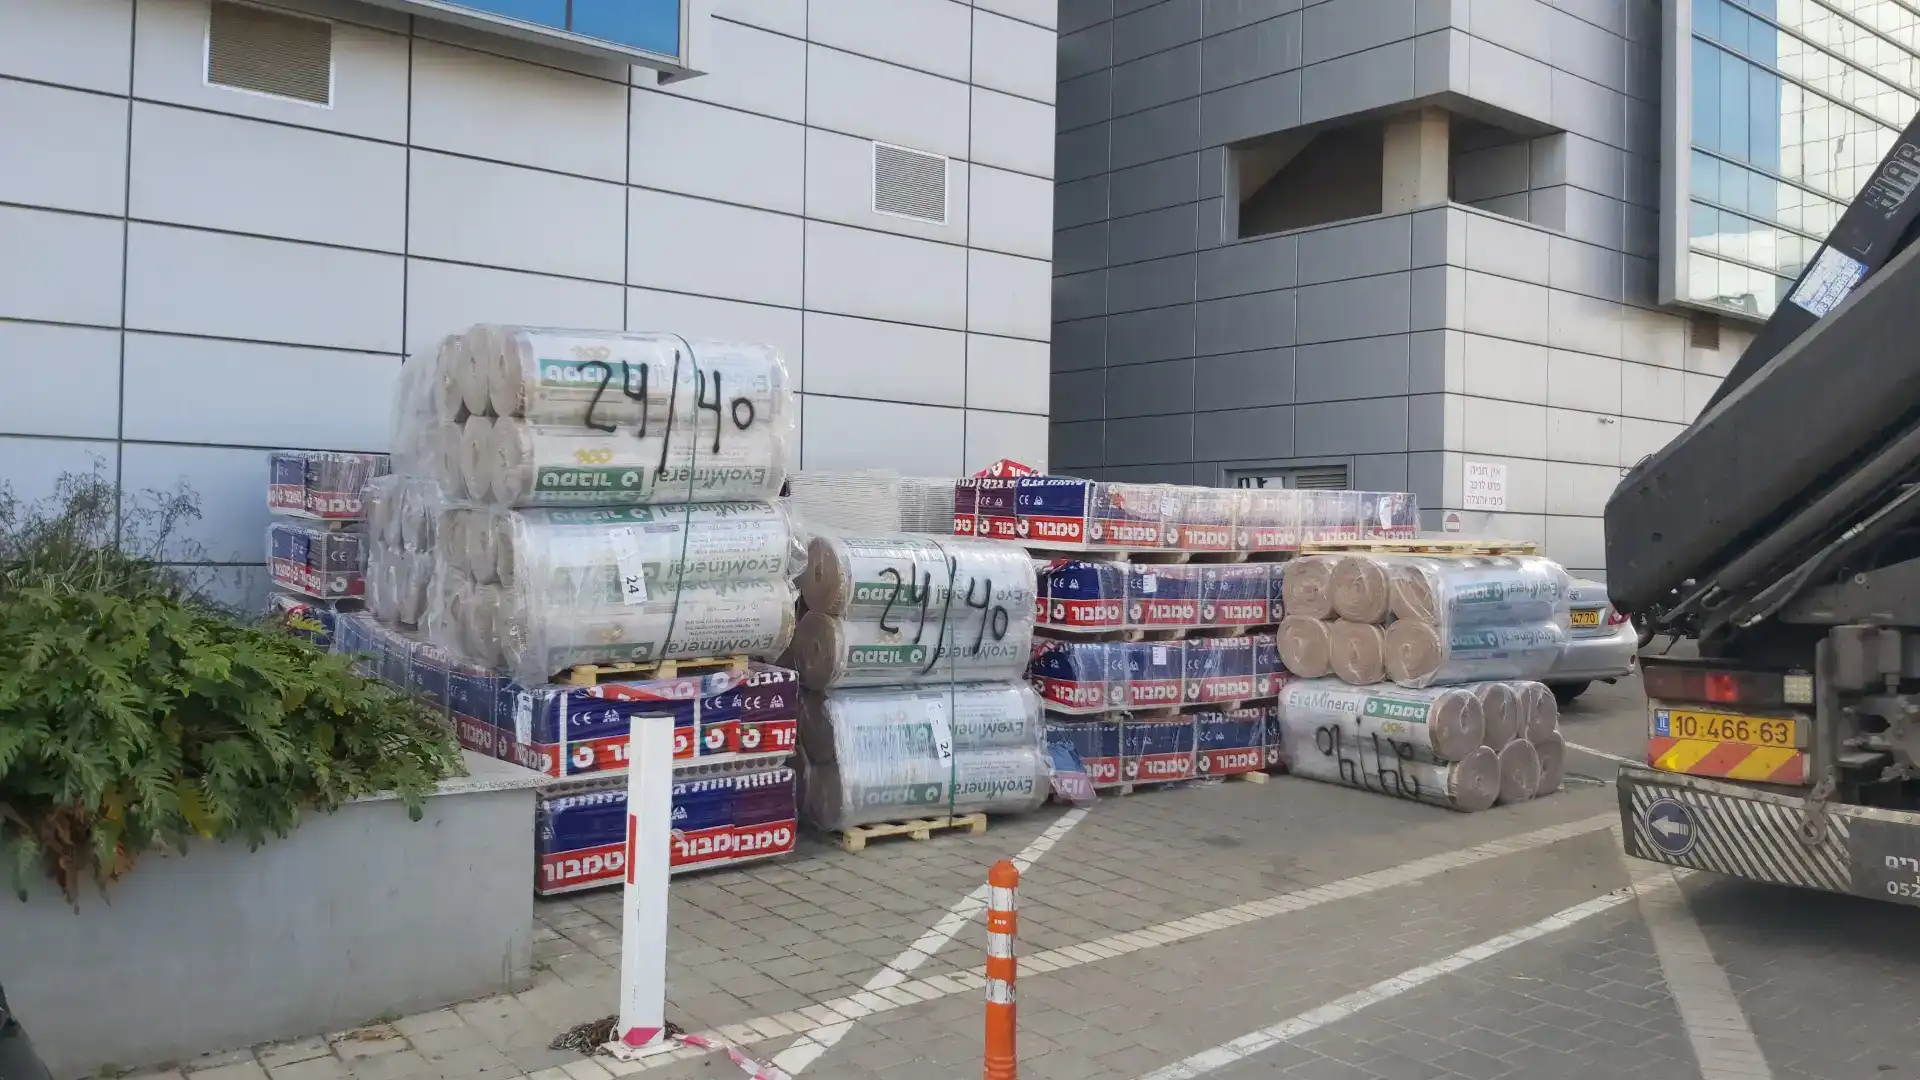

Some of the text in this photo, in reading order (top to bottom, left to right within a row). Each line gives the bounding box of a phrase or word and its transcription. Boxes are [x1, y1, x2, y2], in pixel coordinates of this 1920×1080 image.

[541, 465, 766, 489] EvoMineral טמבור
[1469, 466, 1501, 477] אין חניה
[995, 522, 1015, 535] בור
[1035, 522, 1080, 536] טמבור
[1110, 526, 1156, 541] טמבור
[1185, 530, 1229, 545] טמבור
[1254, 532, 1295, 546] טמבור
[331, 550, 347, 562] CE
[625, 574, 640, 594] 24
[1053, 577, 1064, 588] CE
[1072, 605, 1119, 620] טמבור
[1149, 605, 1194, 619] טמבור
[1221, 605, 1263, 619] טמבור
[851, 650, 902, 664] טמבור
[1052, 684, 1100, 702] טמבור
[1131, 685, 1178, 700] טמבור
[1206, 681, 1249, 697] טמבור
[704, 696, 723, 710] CE
[744, 696, 761, 710] CE
[1289, 690, 1426, 718] EvoMineral טמבור
[572, 711, 592, 726] CE
[1144, 759, 1189, 774] טמבור
[1216, 752, 1258, 769] טמבור
[675, 833, 733, 857] מבור
[542, 851, 625, 882] טמבור
